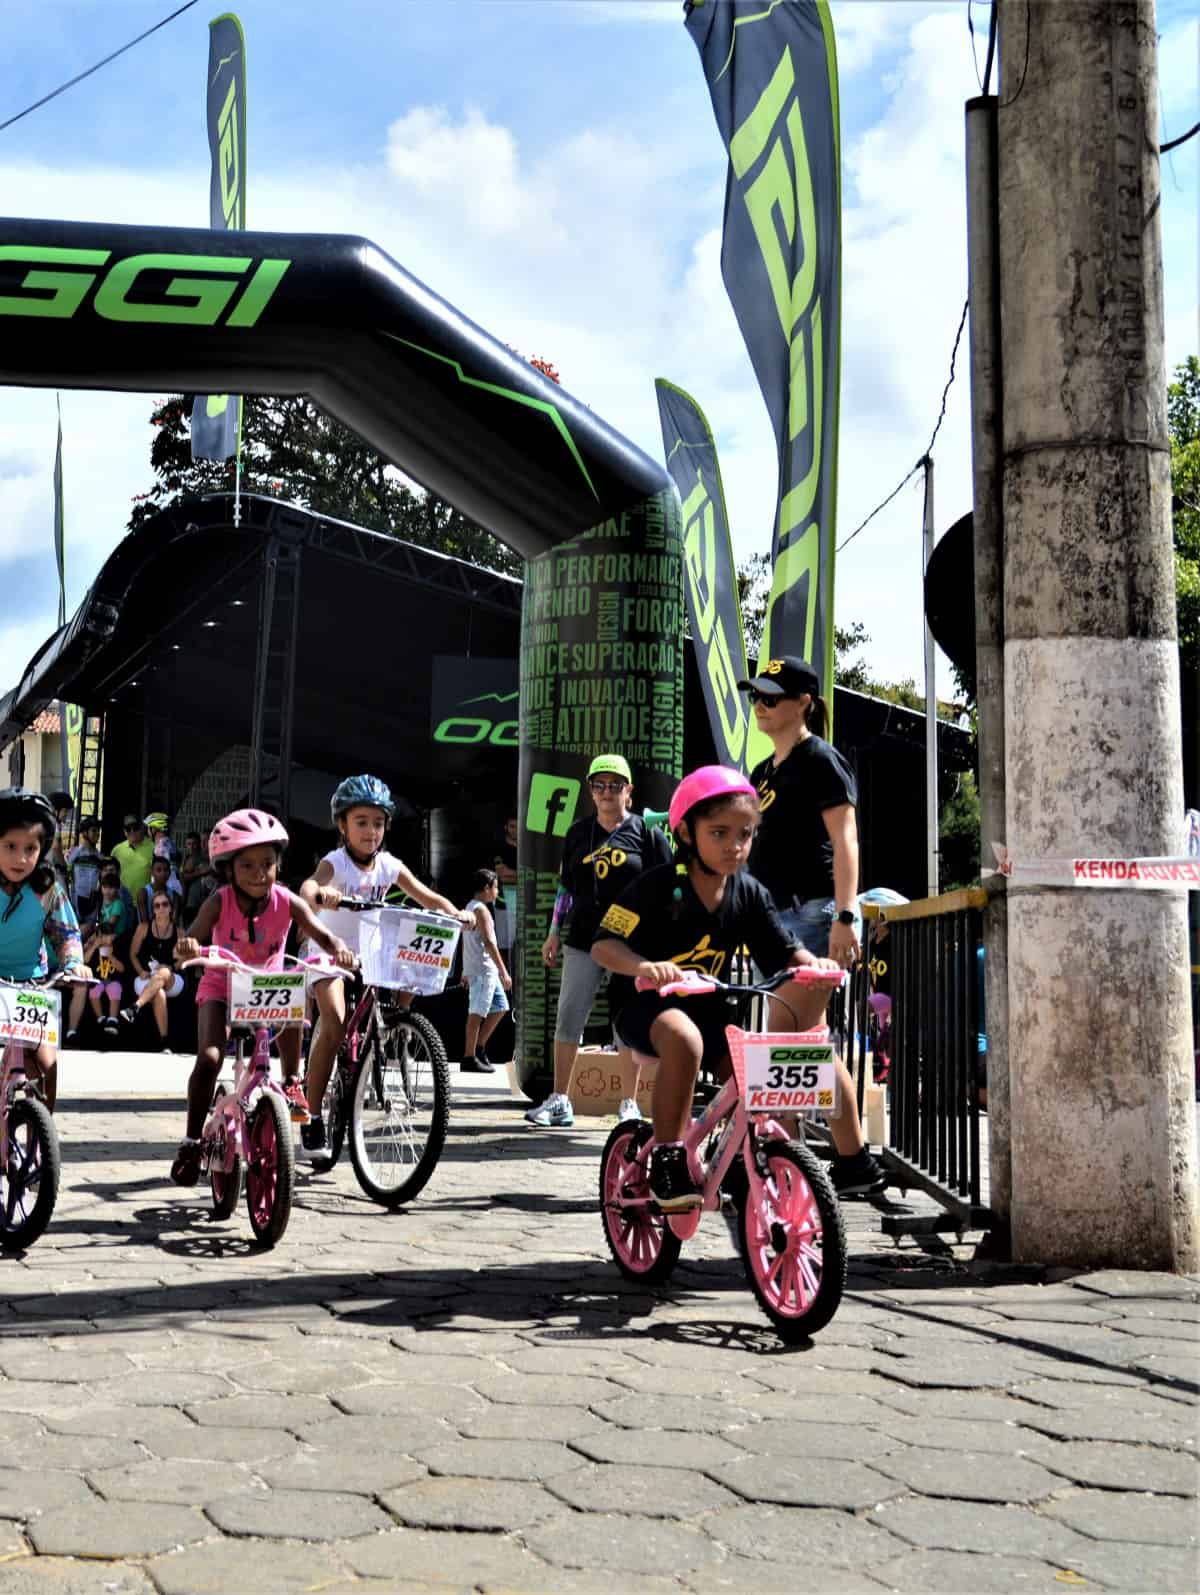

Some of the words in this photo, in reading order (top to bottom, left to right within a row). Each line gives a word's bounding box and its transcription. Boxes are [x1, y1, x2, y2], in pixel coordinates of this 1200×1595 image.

[556, 552, 680, 587] PERFORMANCE
[597, 591, 620, 641] DESIGN
[623, 596, 679, 641] FORÇA
[572, 638, 675, 678] SUPERAÇÃO
[560, 674, 647, 706] INOVAÇÃO
[556, 703, 650, 745] ATITUDE
[651, 679, 676, 761] DESIGN
[1074, 860, 1140, 881] KENDA
[409, 936, 445, 955] 412
[398, 951, 440, 967] KENDA
[248, 988, 291, 1006] 373
[13, 1006, 48, 1027] 394
[234, 1007, 289, 1019] KENDA
[0, 1023, 46, 1041] KENDA
[771, 1049, 832, 1061] OGGI
[766, 1065, 819, 1089] 355
[750, 1091, 816, 1107] KENDA
